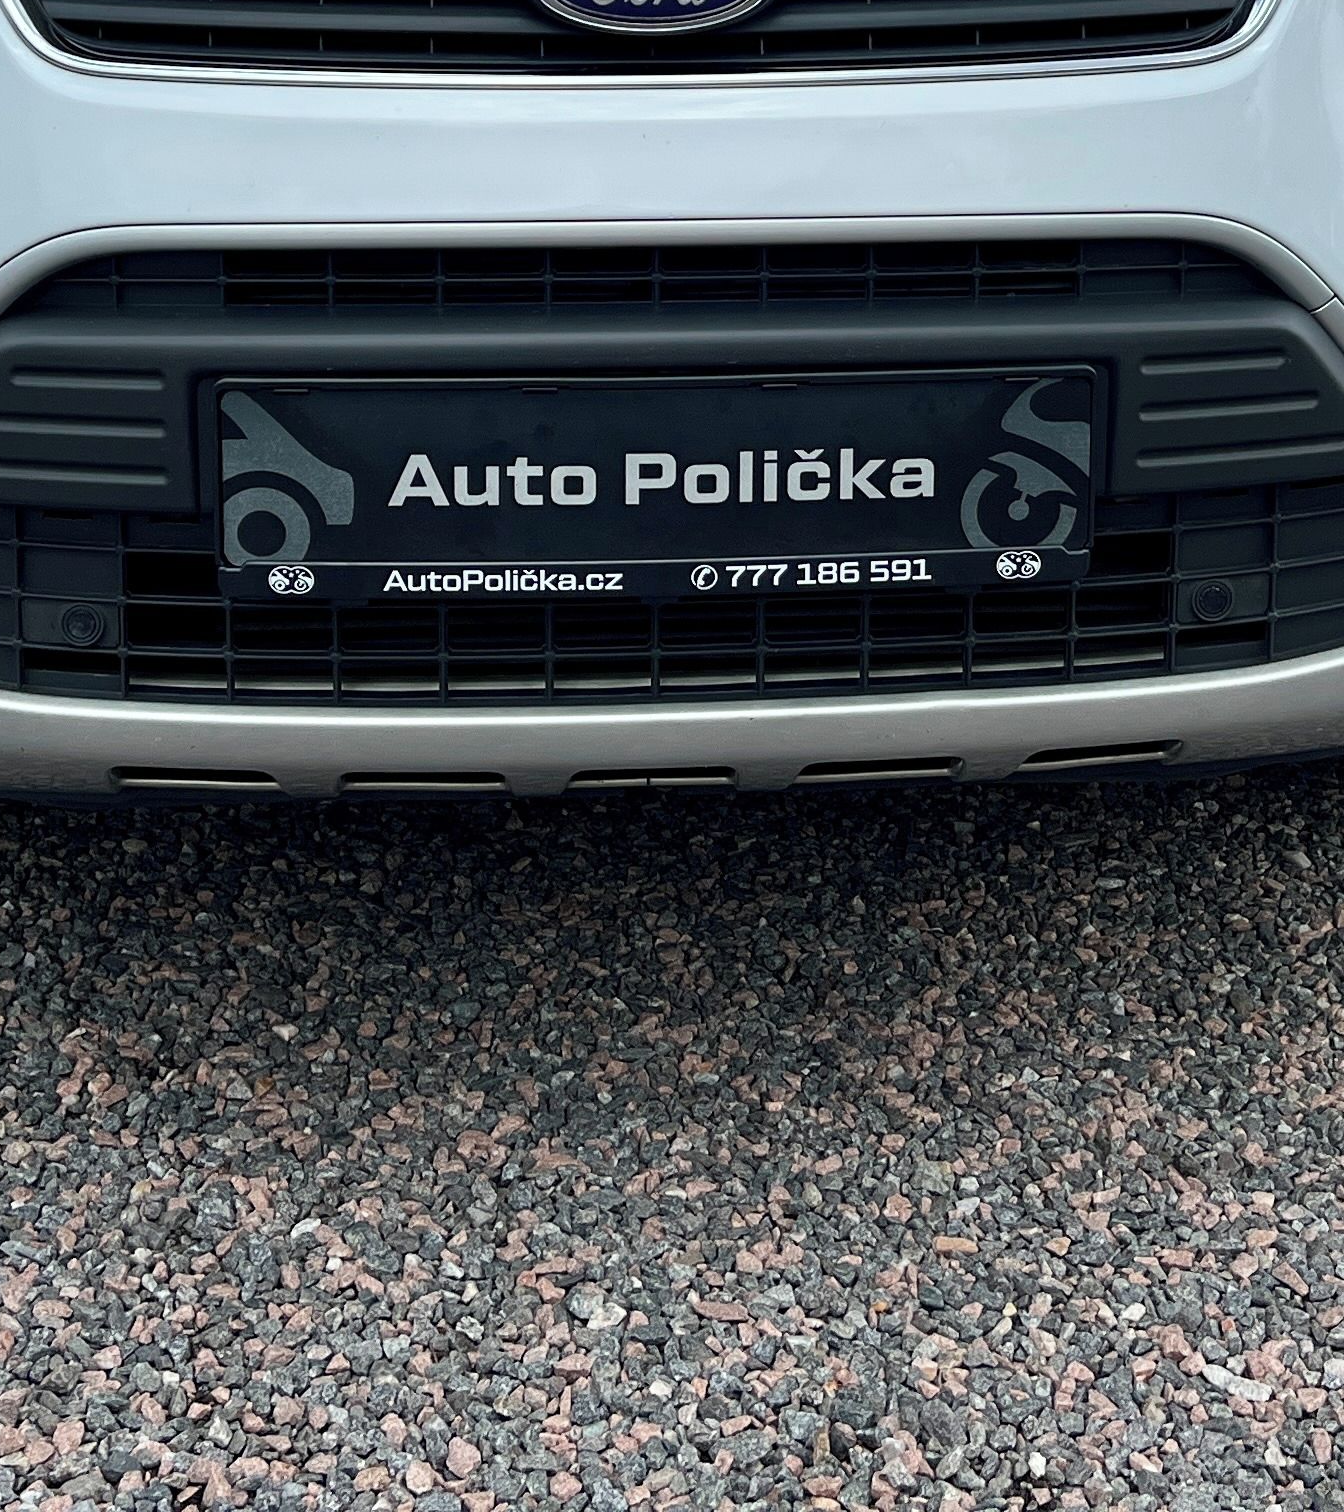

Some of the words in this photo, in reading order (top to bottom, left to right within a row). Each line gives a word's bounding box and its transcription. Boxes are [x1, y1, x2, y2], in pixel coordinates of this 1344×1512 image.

[387, 454, 597, 507] Auto
[625, 447, 936, 505] Polička
[383, 566, 624, 593] AutoPolička.cz
[725, 563, 789, 588] 777
[796, 561, 861, 586] 186
[870, 558, 932, 584] 591
